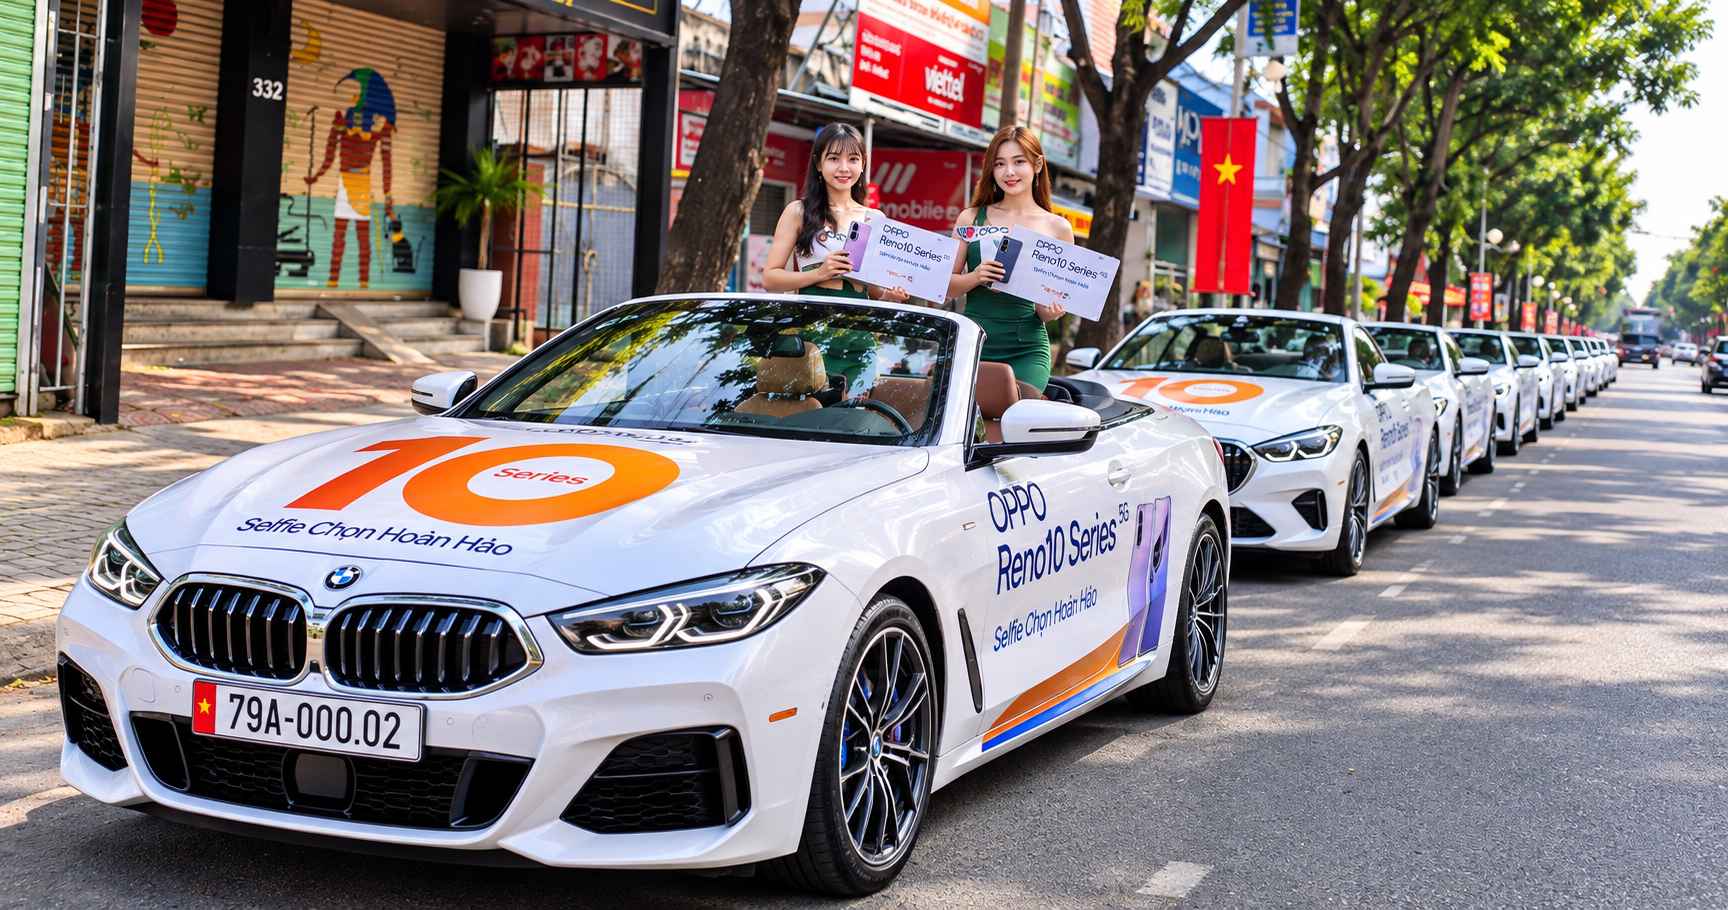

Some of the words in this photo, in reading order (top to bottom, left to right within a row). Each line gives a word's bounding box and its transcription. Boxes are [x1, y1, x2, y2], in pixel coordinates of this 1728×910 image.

[252, 77, 284, 101] 332
[924, 65, 966, 103] viettel
[879, 235, 914, 253] Reno10
[913, 246, 943, 263] Series
[1031, 248, 1068, 270] Reno10
[1067, 260, 1099, 281] Series
[1118, 375, 1266, 406] 10
[283, 436, 681, 526] 10
[493, 467, 588, 486] Series
[987, 482, 1046, 532] OPPO
[236, 517, 307, 534] Selfie
[308, 521, 377, 542] Chọn
[996, 525, 1066, 595] Reno10
[1068, 511, 1118, 567] Series
[1118, 501, 1130, 524] 5G
[993, 617, 1024, 652] Selfie
[1025, 608, 1052, 637] Chọn
[229, 693, 402, 750] 79A-000.02
